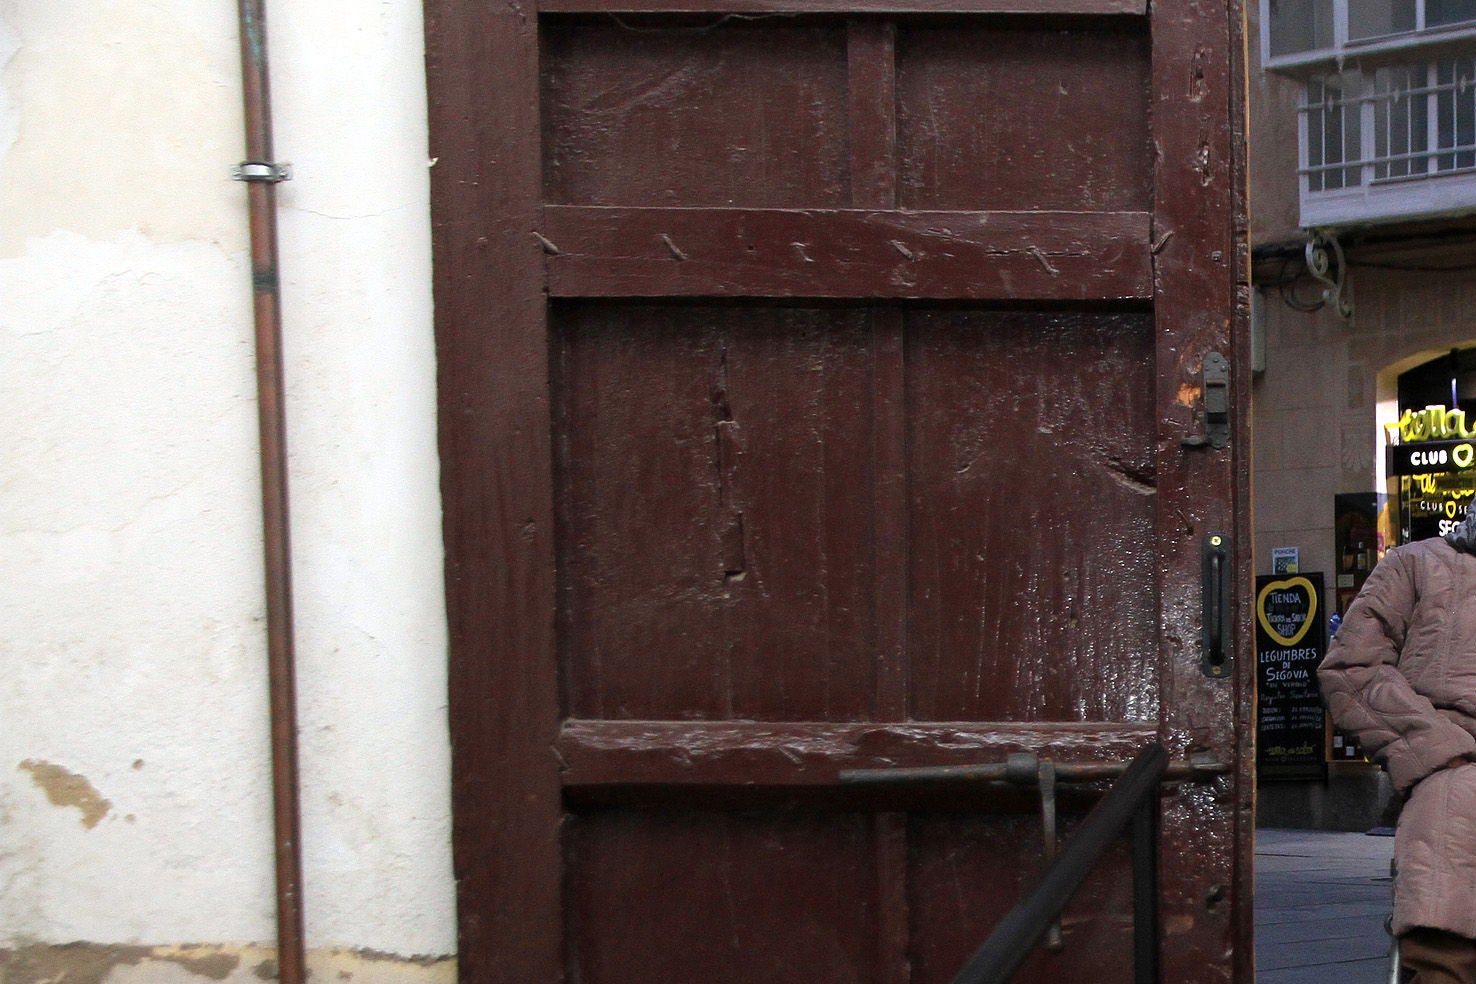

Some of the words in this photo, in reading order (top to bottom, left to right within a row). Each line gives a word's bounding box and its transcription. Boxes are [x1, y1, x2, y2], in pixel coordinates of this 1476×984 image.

[1410, 449, 1448, 466] CLUB
[1420, 500, 1443, 512] CLUB
[1270, 592, 1301, 604] TIENDA
[1260, 648, 1317, 663] LEGUMBRES
